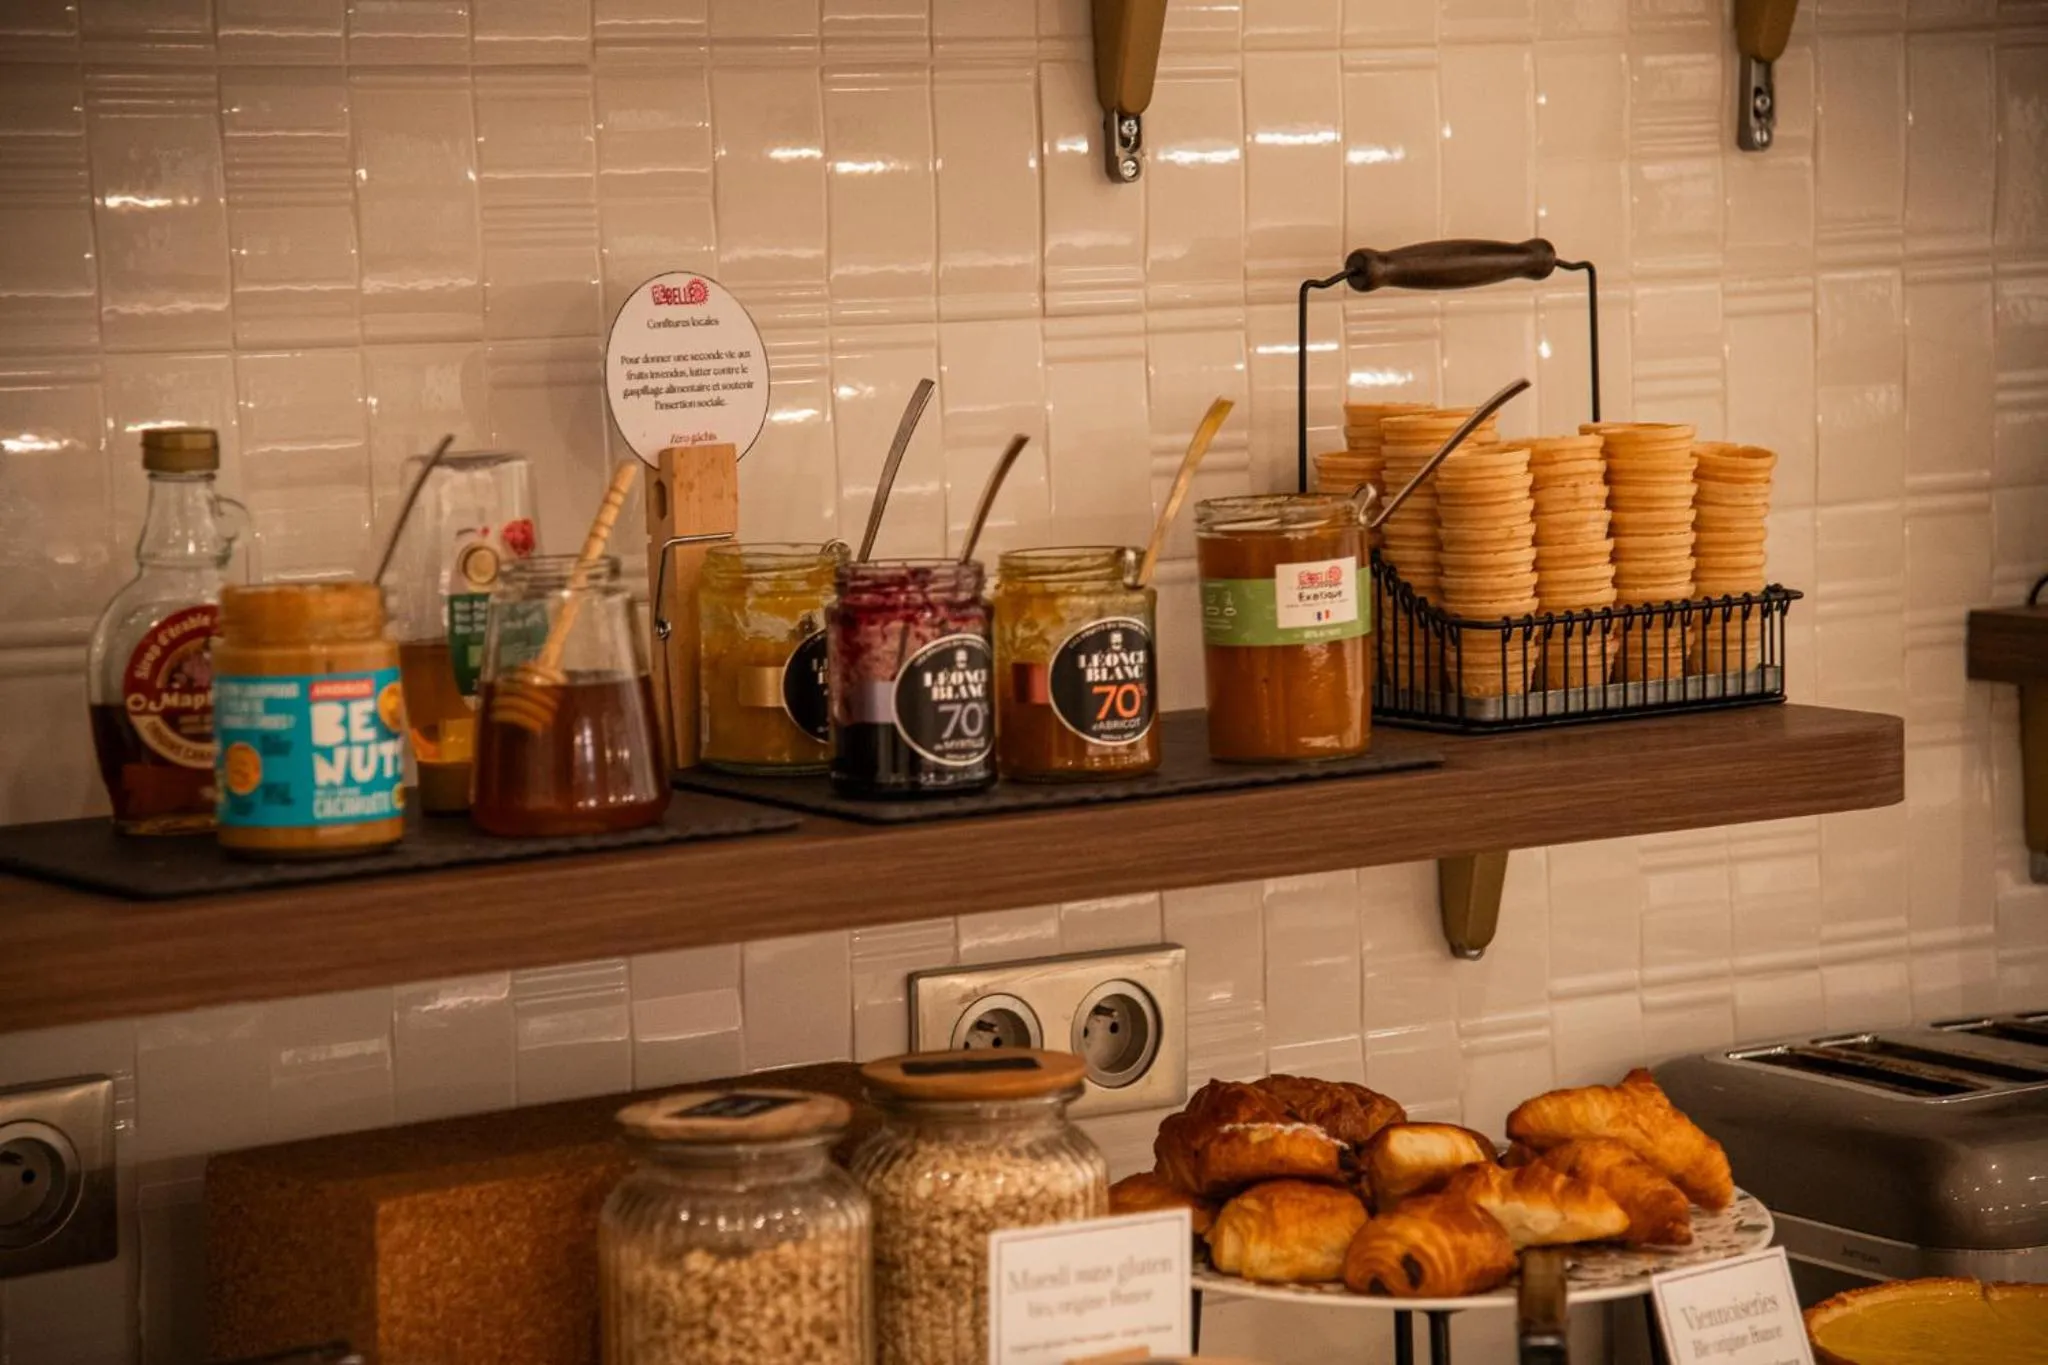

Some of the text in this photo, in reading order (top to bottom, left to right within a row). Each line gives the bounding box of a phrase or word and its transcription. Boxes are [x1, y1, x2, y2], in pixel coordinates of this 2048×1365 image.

[647, 315, 720, 329] Confitures locales
[620, 350, 751, 365] Pour donner une seconde vie aux
[626, 370, 649, 380] fruits
[689, 366, 711, 377] lutter
[712, 365, 740, 375] contre
[740, 364, 749, 374] le
[623, 381, 754, 400] gaspillage alimentaire et soutenir
[654, 399, 696, 410] l'insertion
[1298, 590, 1343, 603] Exotique
[1086, 665, 1144, 682] BLANC
[149, 690, 214, 711] Mapl
[931, 684, 985, 701] BLANC
[310, 699, 377, 746] BE
[1117, 1253, 1172, 1286] gluten
[1680, 1292, 1779, 1332] Viennoiseries
